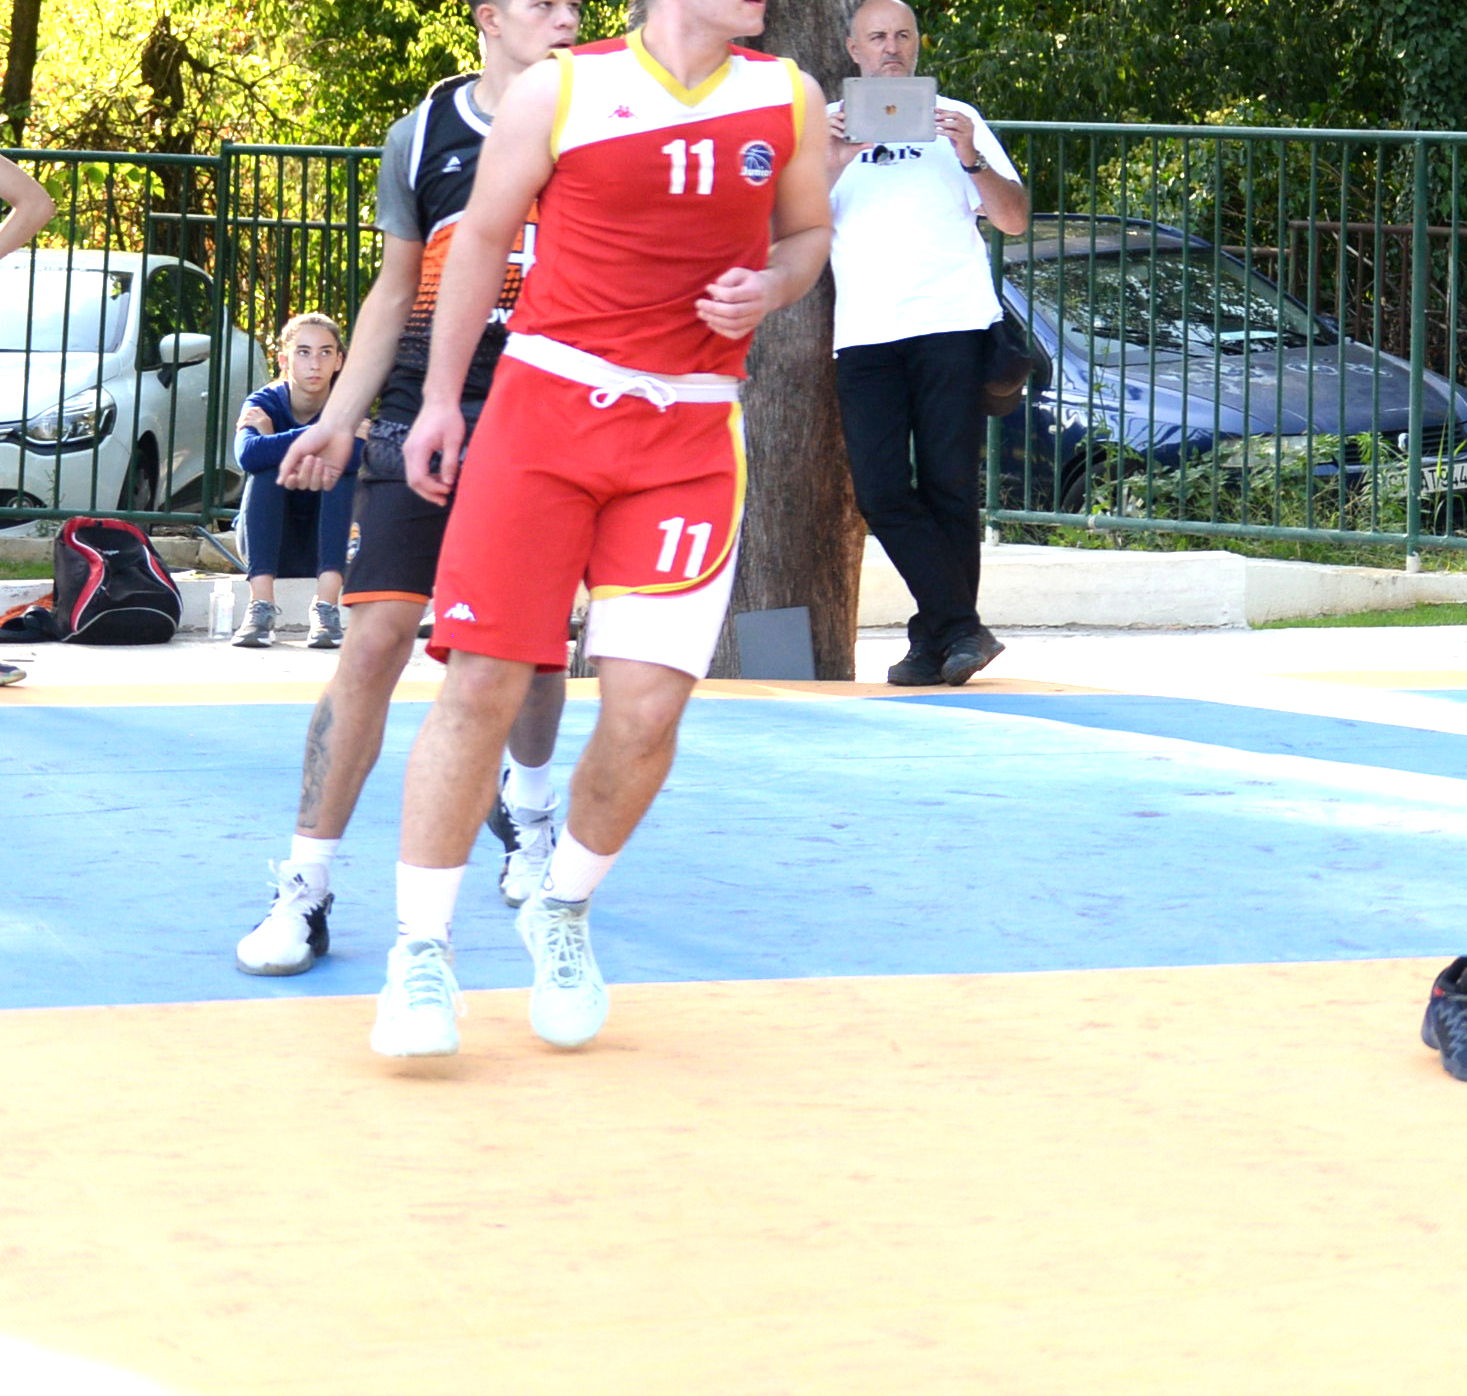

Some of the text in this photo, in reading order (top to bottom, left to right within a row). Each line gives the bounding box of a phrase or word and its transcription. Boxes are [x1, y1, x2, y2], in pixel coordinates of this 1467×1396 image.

[661, 139, 715, 195] 11
[860, 145, 924, 164] LI'S
[656, 516, 713, 578] 11
